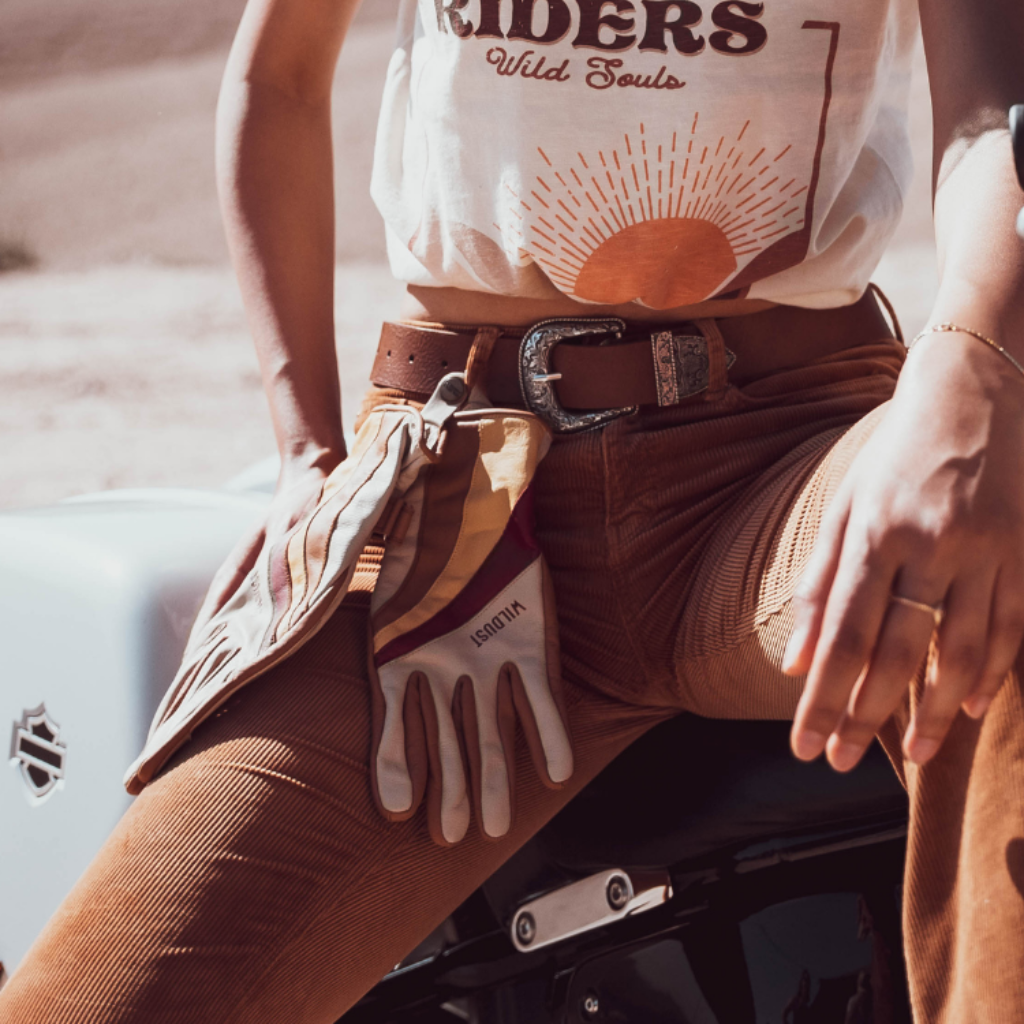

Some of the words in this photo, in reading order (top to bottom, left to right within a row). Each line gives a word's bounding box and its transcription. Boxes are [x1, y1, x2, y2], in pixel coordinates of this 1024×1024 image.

[486, 47, 570, 82] Wild
[585, 57, 686, 90] Souls
[470, 599, 527, 648] WILDUST
